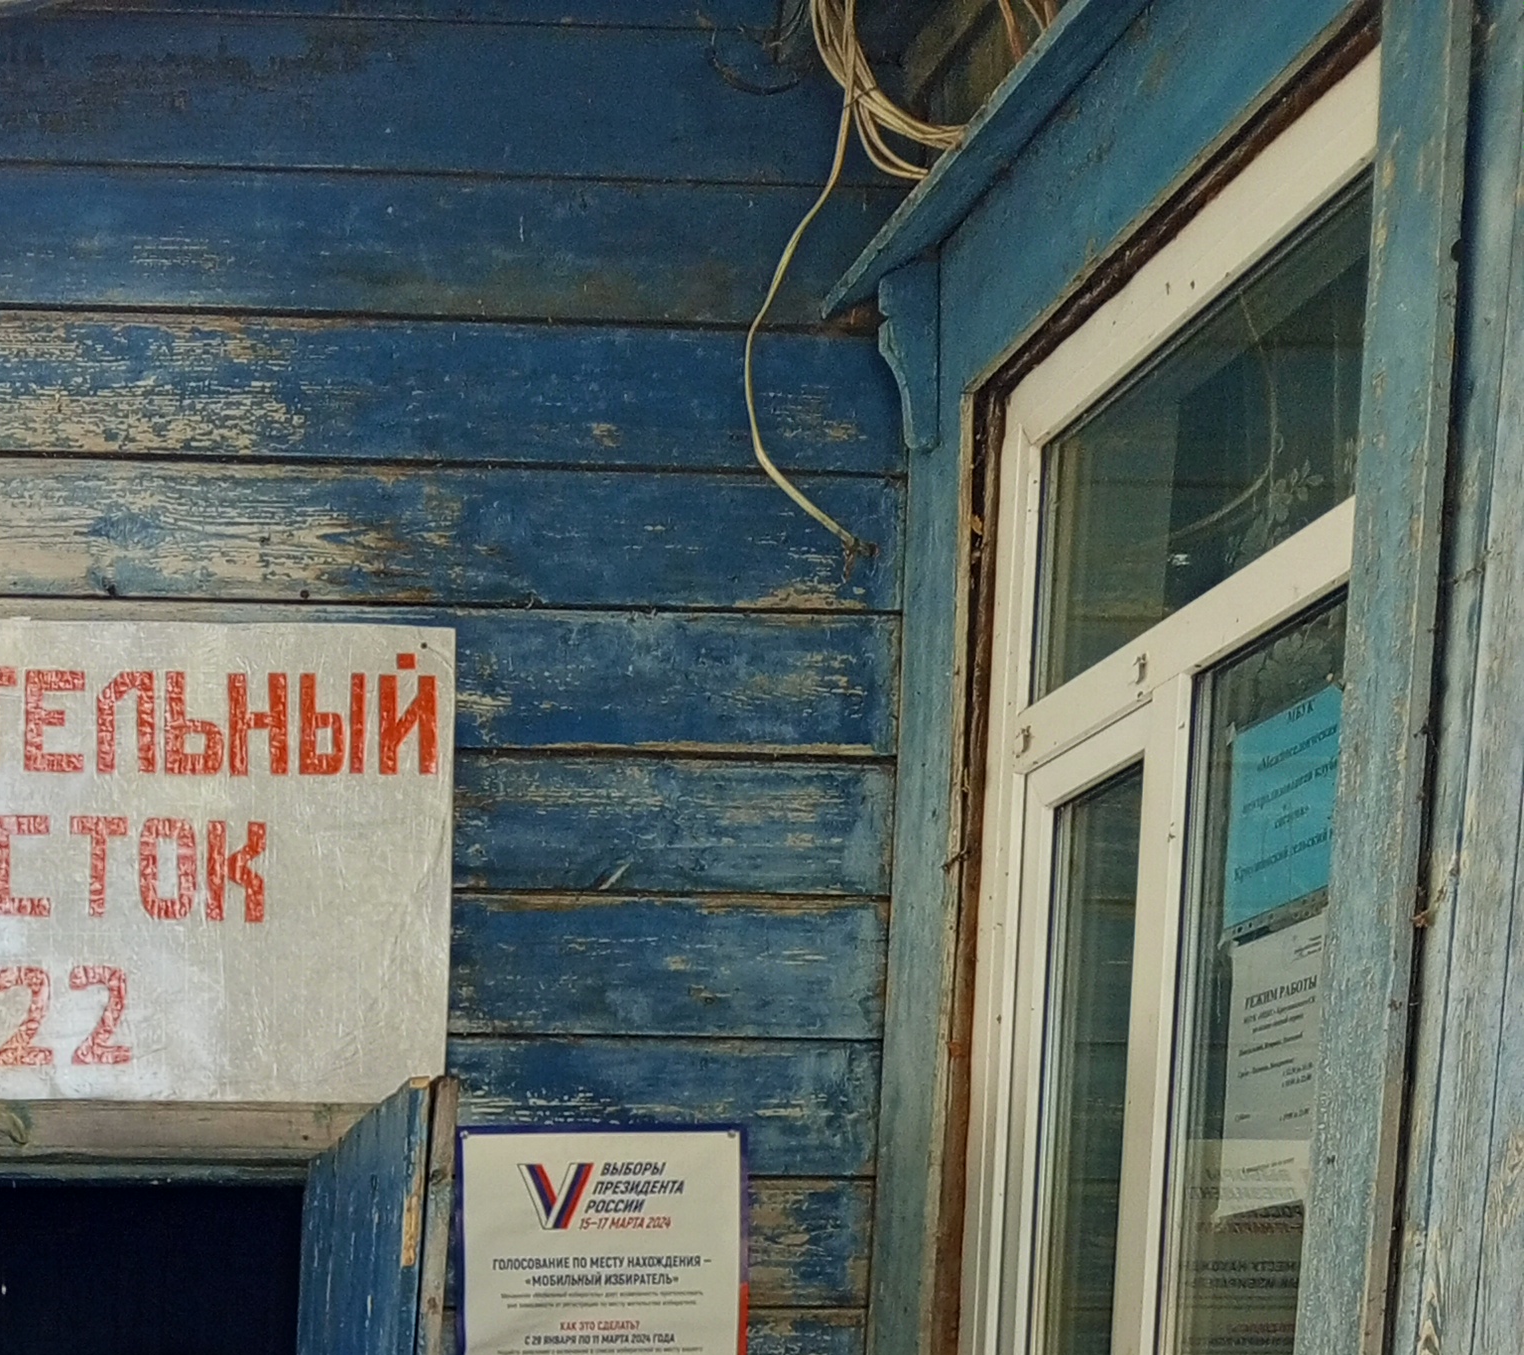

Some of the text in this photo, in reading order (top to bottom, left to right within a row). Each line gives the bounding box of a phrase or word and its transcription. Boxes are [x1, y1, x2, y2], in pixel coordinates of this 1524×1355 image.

[1279, 974, 1318, 1001] РАБОТЫ
[600, 1162, 666, 1176] ВЫБОРЫ
[592, 1180, 686, 1195] ПРЕЗИДЕНТА
[585, 1199, 645, 1214] РОССИИ
[609, 1217, 645, 1230] МАРТА
[646, 1216, 672, 1230] 2024
[492, 1257, 569, 1271] ГОЛОСОВАНИЕ
[573, 1257, 588, 1269] ПО
[590, 1257, 625, 1269] МЕСТУ
[628, 1255, 701, 1269] НАХОЖДЕНИЯ
[525, 1272, 679, 1287] «МОБИЛЬНЫЙ ИЗБИРАТЕЛЬ»
[560, 1321, 576, 1331] КАК
[578, 1321, 596, 1331] ЭТО
